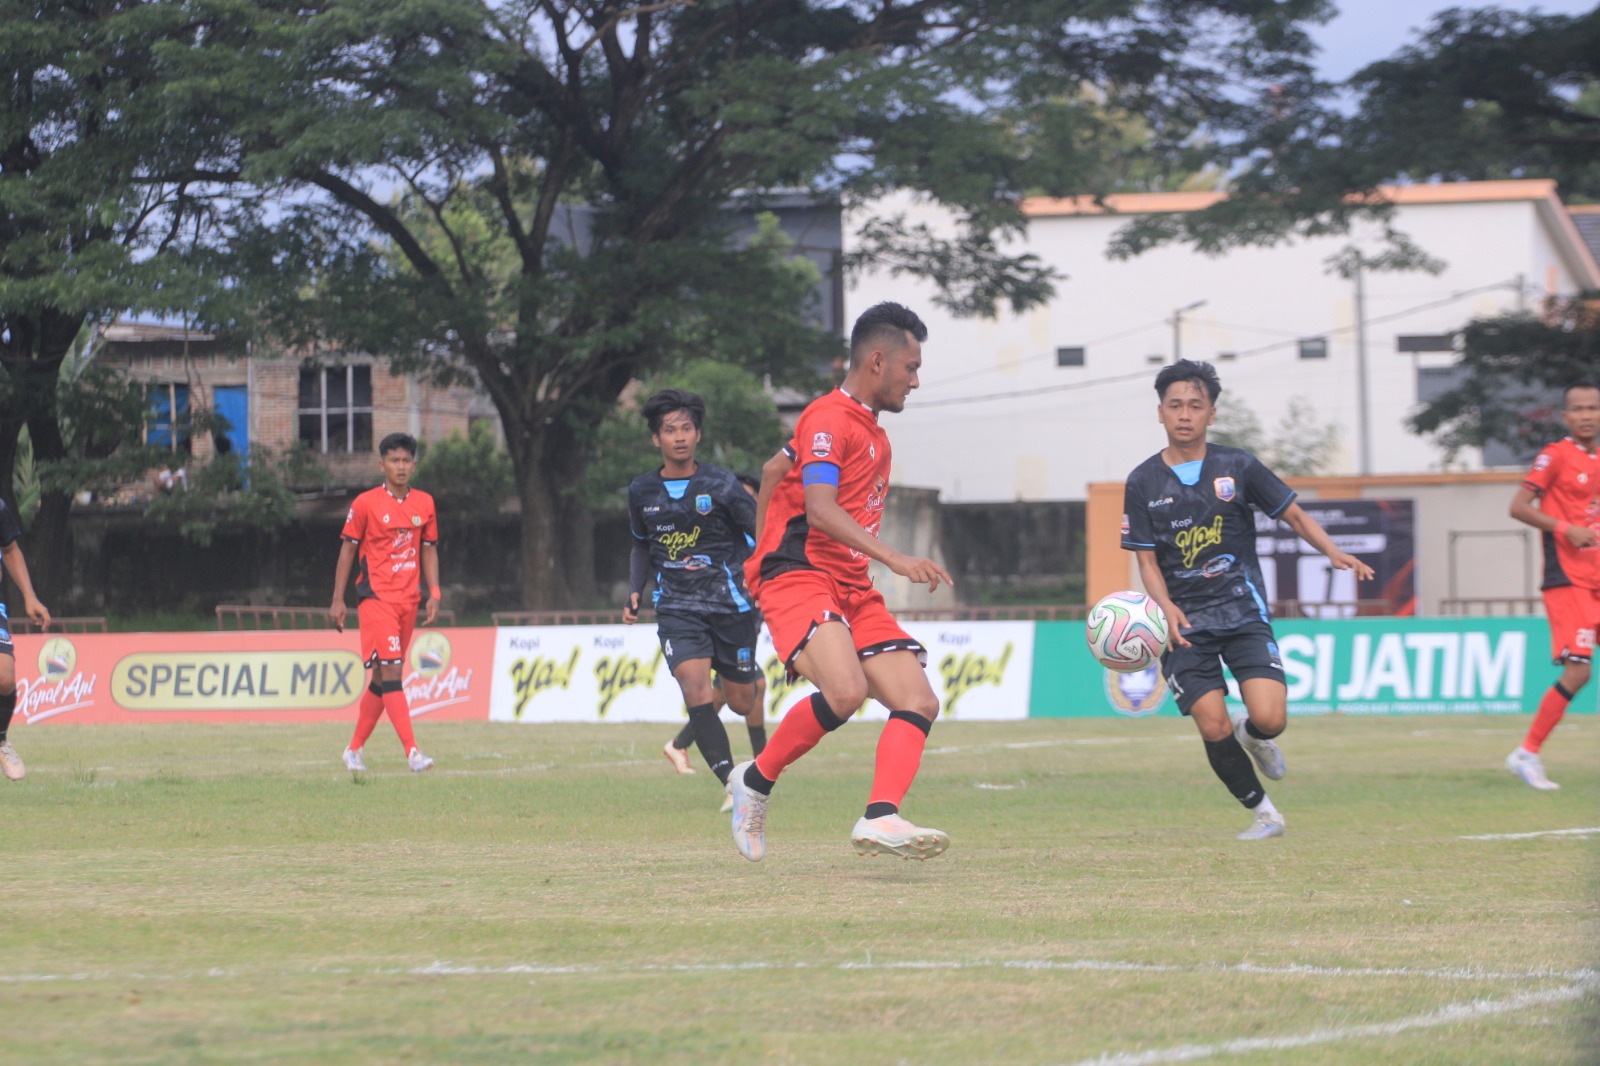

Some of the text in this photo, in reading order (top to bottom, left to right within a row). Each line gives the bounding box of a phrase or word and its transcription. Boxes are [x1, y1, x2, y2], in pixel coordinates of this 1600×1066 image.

[656, 523, 675, 532] Kopi
[1170, 515, 1193, 528] Kopi
[509, 636, 541, 650] Kopi
[593, 634, 625, 649] Kopi
[937, 631, 972, 646] Kopi
[1337, 631, 1527, 700] JATIM
[125, 661, 355, 698] SPECIAL MIX
[14, 672, 97, 717] Kapal Api
